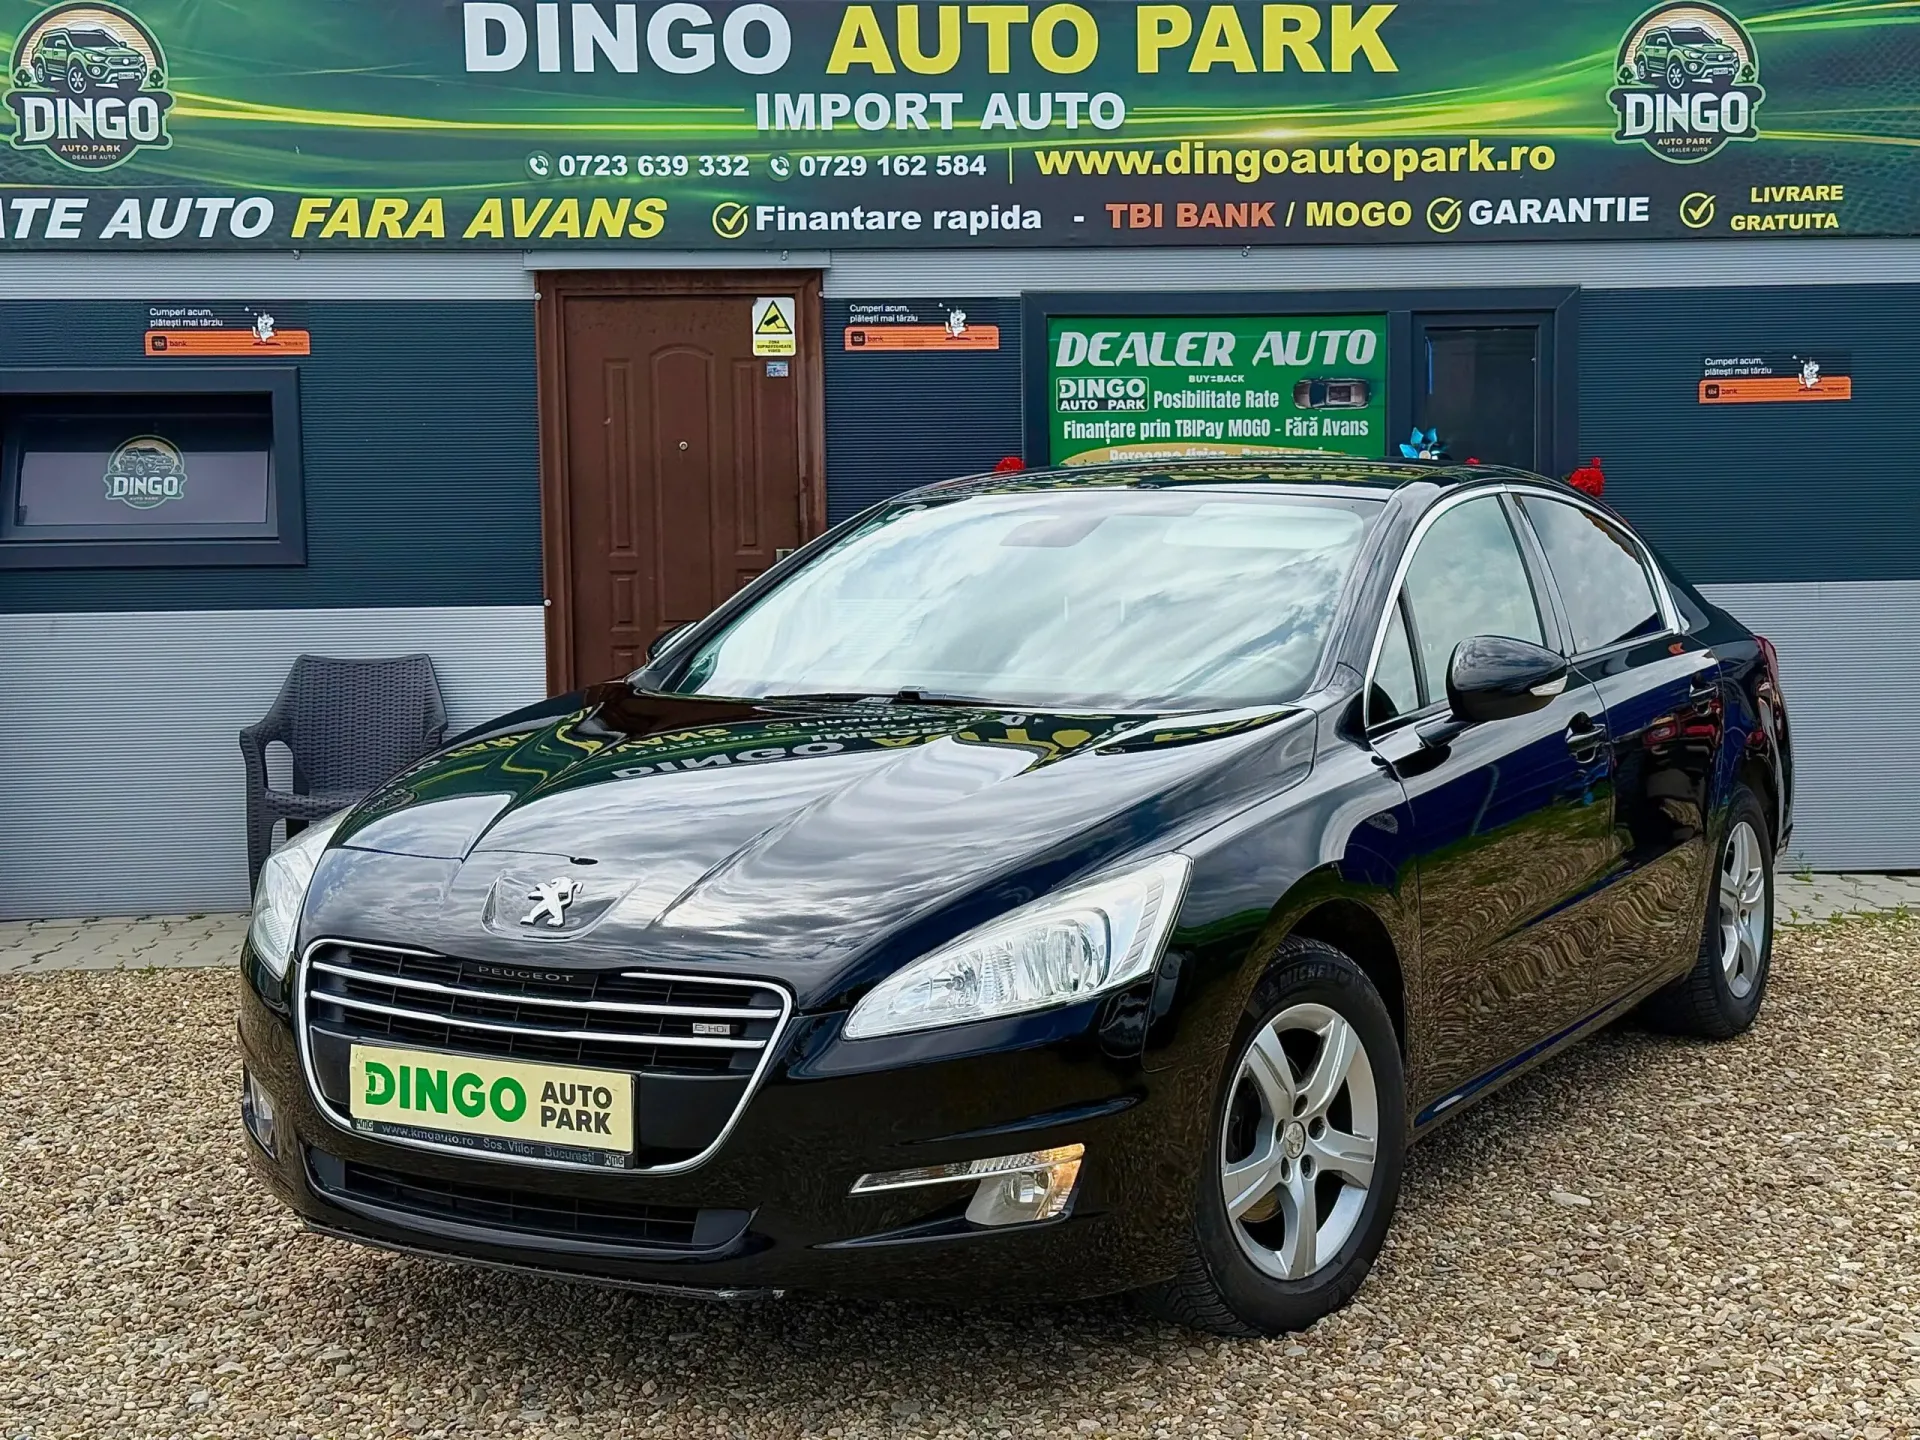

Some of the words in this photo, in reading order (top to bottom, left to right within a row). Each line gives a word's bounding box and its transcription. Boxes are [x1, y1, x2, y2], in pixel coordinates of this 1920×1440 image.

[463, 2, 792, 75] DINGO
[825, 3, 1099, 75] AUTO
[1136, 4, 1399, 73] PARK
[21, 96, 160, 142] DINGO
[755, 92, 963, 131] IMPORT
[980, 92, 1127, 130] AUTO
[1623, 91, 1749, 137] DINGO
[60, 144, 88, 153] AUTO
[93, 144, 121, 153] PARK
[1657, 138, 1683, 146] AUTO
[1686, 137, 1712, 145] PARK
[558, 155, 628, 176] 0723
[637, 155, 689, 177] 639
[698, 155, 750, 176] 332
[799, 155, 867, 177] 0729
[877, 155, 927, 176] 162
[936, 155, 987, 176] 584
[1036, 139, 1557, 182] www.dingoautopark.ro
[1751, 185, 1844, 203] LIVRARE
[0, 197, 88, 239] TE
[98, 197, 274, 239] AUTO
[291, 198, 445, 239] FARA
[462, 197, 668, 239] AVANS
[756, 205, 922, 231] Finantare
[933, 204, 1042, 236] rapida
[1105, 203, 1162, 230] TBI
[1176, 202, 1276, 229] BANK
[1306, 200, 1412, 227] MOGO
[1468, 196, 1650, 225] GARANTIE
[1730, 212, 1839, 231] GRATUITA
[149, 307, 186, 319] Cumperi
[849, 304, 884, 315] Cumperi
[1055, 331, 1236, 367] DEALER
[1252, 329, 1377, 366] AUTO
[1704, 358, 1738, 367] Cumperi
[1059, 378, 1146, 398] DINGO
[1060, 400, 1098, 410] AUTO
[1107, 399, 1146, 410] PARK
[1153, 390, 1241, 409] Posibilitate
[1245, 390, 1279, 409] Rate
[1063, 420, 1136, 444] Finanțare
[1139, 419, 1171, 440] prin
[1174, 419, 1224, 440] TBIPay
[1228, 418, 1271, 437] MOGO
[1285, 416, 1319, 437] Fără
[1322, 418, 1369, 437] Avans
[112, 476, 179, 496] DINGO
[478, 966, 574, 982] PEUGEOT
[364, 1060, 528, 1123] DINGO
[539, 1080, 613, 1108] AUTO
[539, 1105, 613, 1136] PARK
[482, 1137, 505, 1151] Sos.
